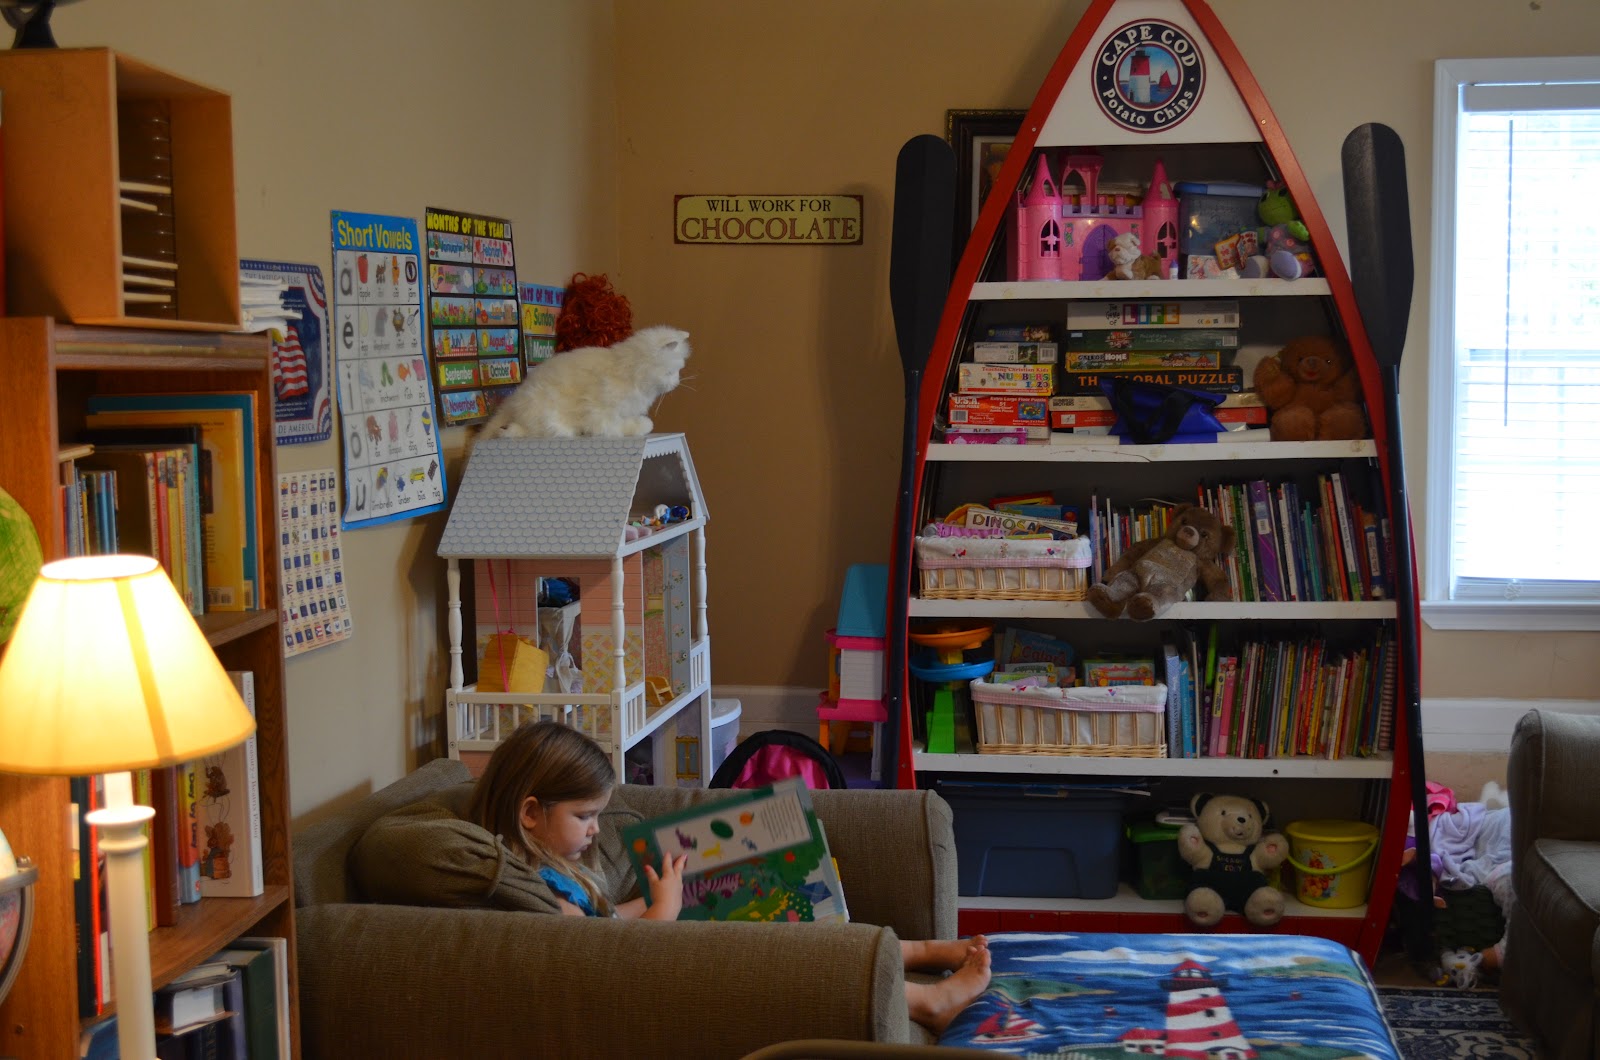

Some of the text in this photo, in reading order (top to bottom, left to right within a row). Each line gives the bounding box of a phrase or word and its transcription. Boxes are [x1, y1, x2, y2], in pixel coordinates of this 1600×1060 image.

[1103, 26, 1196, 67] CAPE COD
[1103, 88, 1193, 125] Potato Chips
[707, 199, 832, 213] WILL WORK FOR
[427, 213, 504, 239] MONTHS OF THE YEAR
[681, 217, 857, 240] CHOCOLATE
[337, 219, 413, 251] Short Vowels
[535, 291, 543, 303] OF
[545, 292, 554, 304] THE
[533, 308, 556, 327] Sunday
[1124, 304, 1180, 325] LIFE
[489, 334, 507, 351] August
[1105, 353, 1128, 361] HOME
[445, 364, 473, 382] September
[490, 364, 510, 379] October
[998, 373, 1050, 381] NUMBERS
[1078, 374, 1237, 387] TH OBAL PUZZLE
[449, 398, 477, 413] November
[278, 425, 287, 434] DE
[189, 802, 196, 818] by
